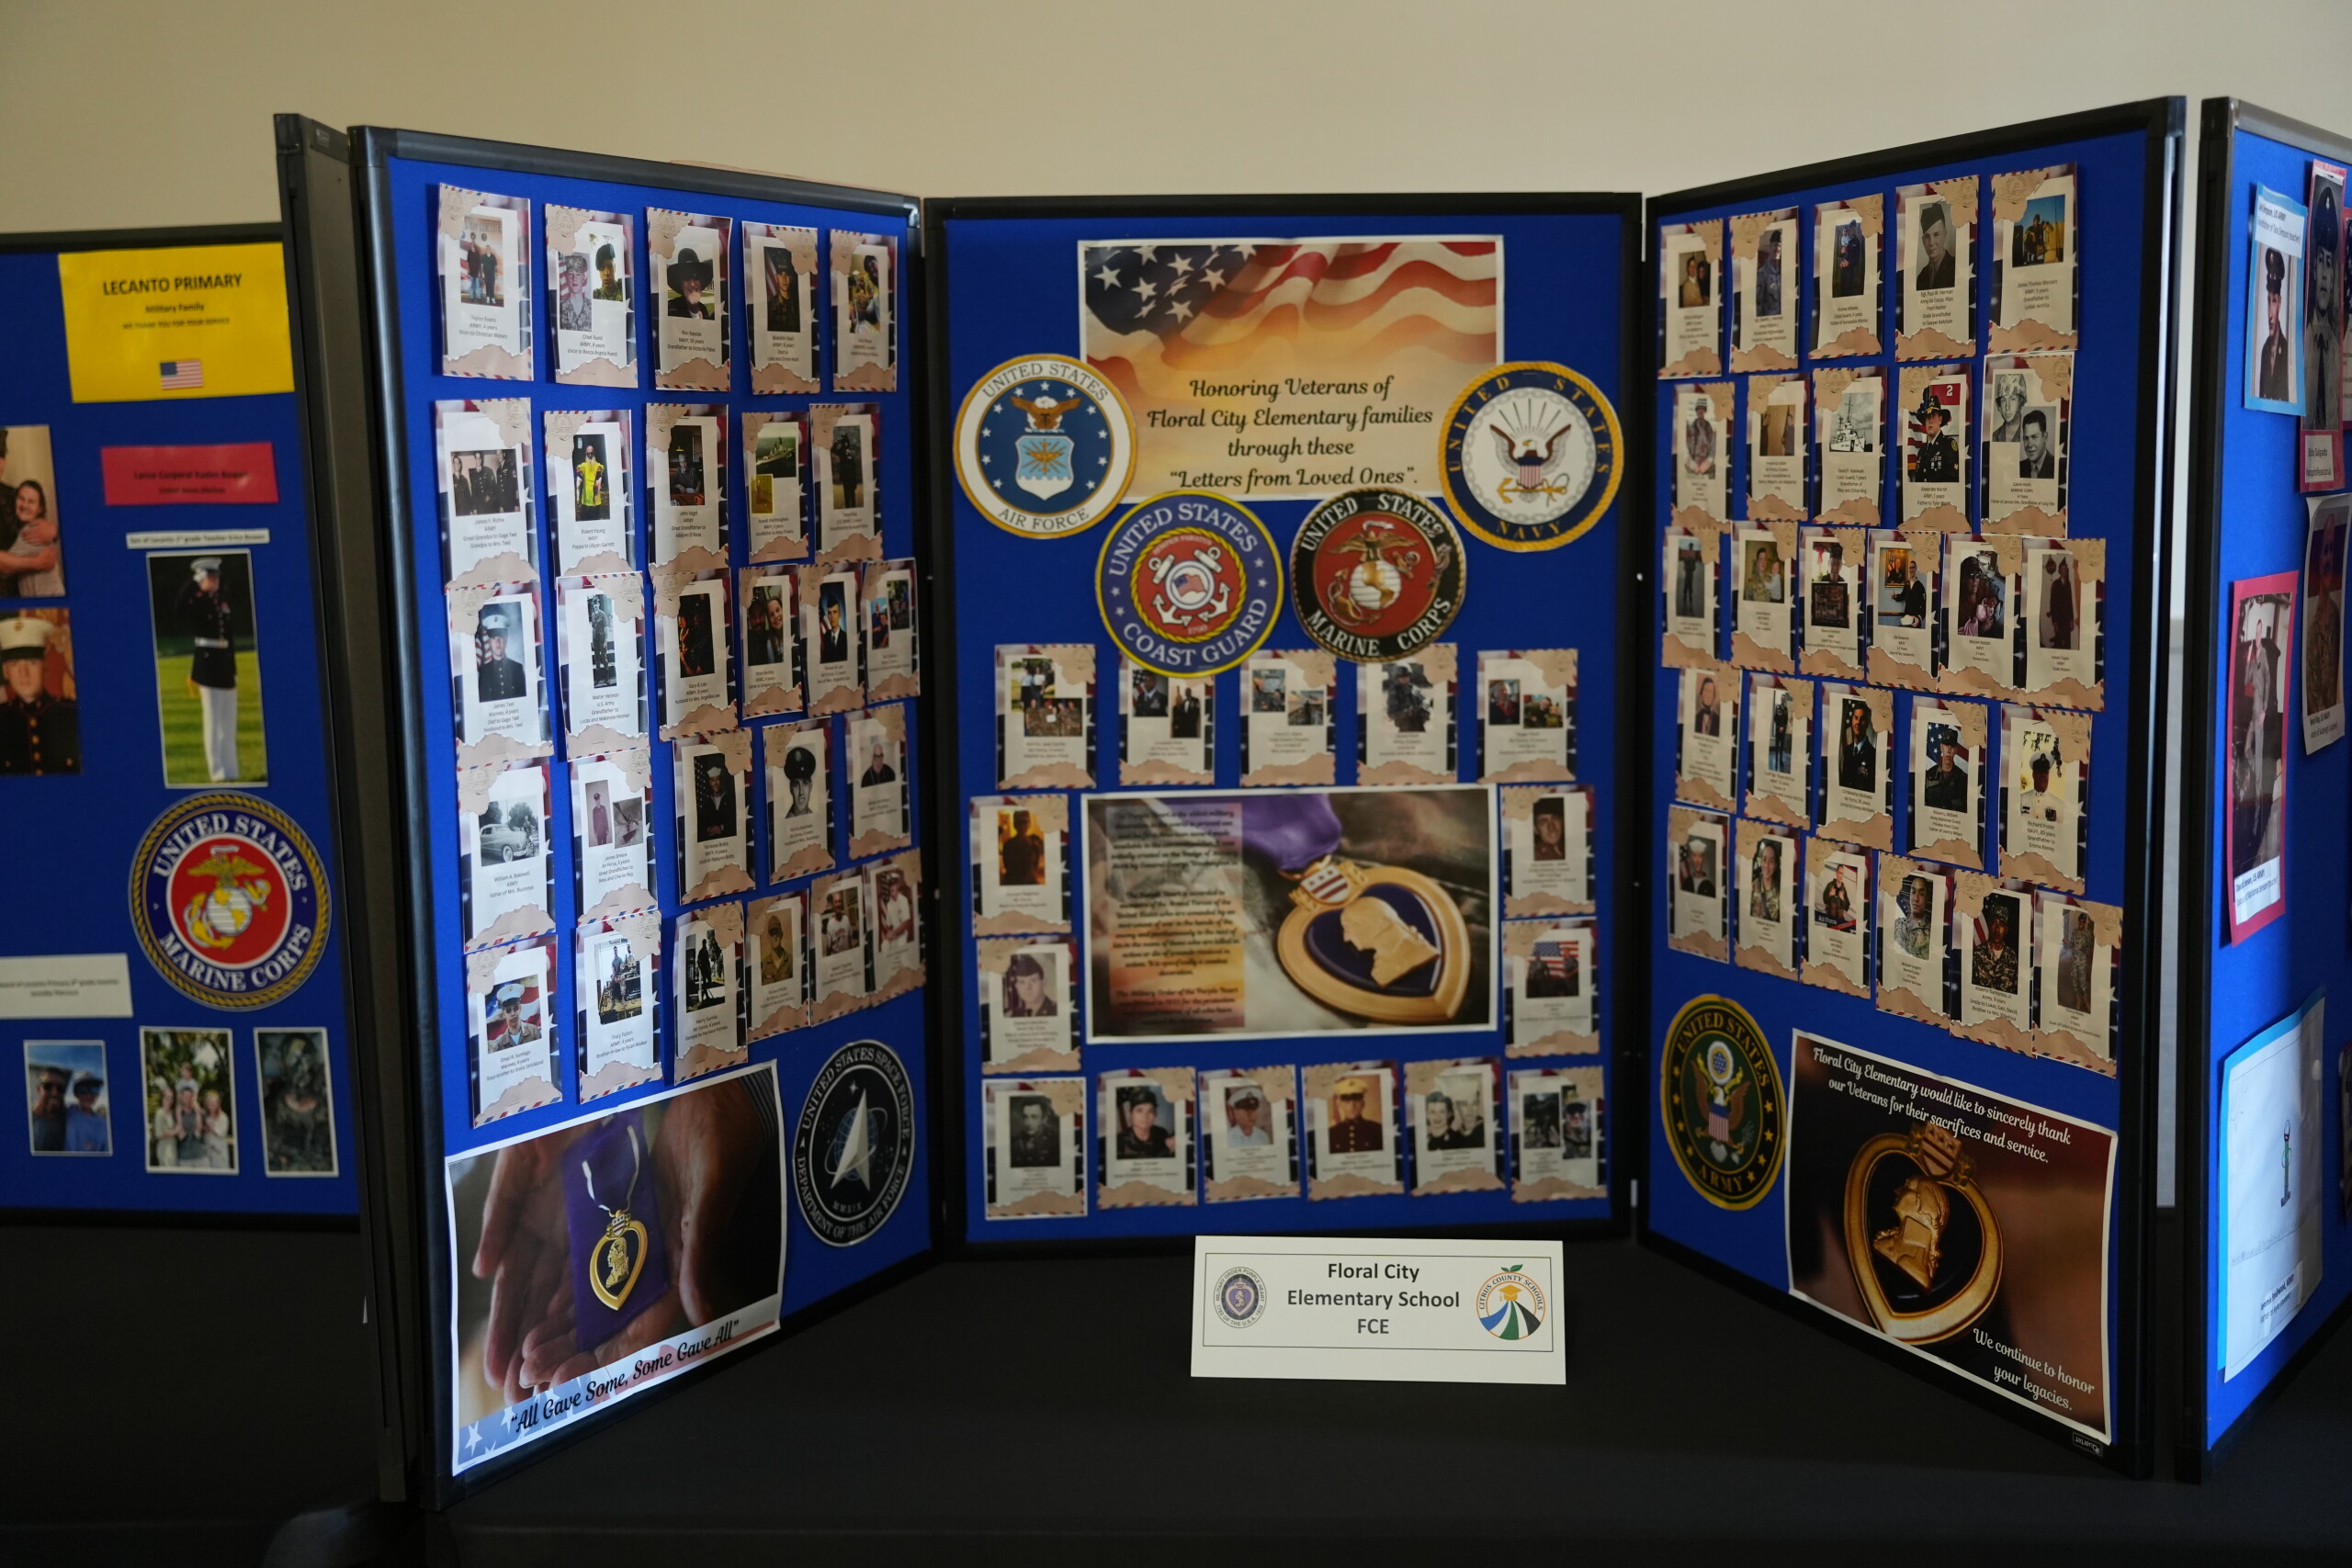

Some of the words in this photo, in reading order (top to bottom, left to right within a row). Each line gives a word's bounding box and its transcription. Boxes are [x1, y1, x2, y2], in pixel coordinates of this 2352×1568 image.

[103, 277, 170, 296] LECANTO
[175, 273, 243, 291] PRIMARY
[145, 304, 176, 314] Military
[178, 302, 204, 313] Family
[982, 363, 1043, 399] UNITED
[1049, 363, 1109, 401] STATES
[1190, 379, 1280, 403] Honoring
[1284, 378, 1368, 396] Veterans
[1374, 375, 1395, 401] of
[1147, 409, 1205, 428] Floral
[1211, 409, 1248, 434] City
[1253, 409, 1359, 433] Elementary
[1359, 405, 1434, 433] families
[1448, 376, 1510, 472] UNITED
[1554, 378, 1611, 474] STATES
[1227, 438, 1303, 463] through
[1306, 436, 1355, 456] these
[1244, 468, 1292, 494] from
[1295, 467, 1353, 486] Loved
[998, 508, 1026, 528] AIR
[1032, 507, 1090, 531] FORCE
[1108, 507, 1173, 577] UNITED
[1178, 502, 1258, 553] STATES
[1300, 497, 1359, 552] UNITED
[1377, 492, 1444, 539] STATES
[1496, 520, 1561, 540] NAVY
[1123, 622, 1198, 667] COAST
[1202, 597, 1268, 663] GUARD
[1306, 608, 1381, 657] MARINE
[1396, 597, 1452, 650] CORPS
[153, 813, 230, 877] UNITED
[233, 814, 308, 891] STATES
[158, 931, 247, 991] MARINE
[250, 923, 312, 988] CORPS
[1677, 1012, 1724, 1055] UNITED
[1726, 1017, 1770, 1088] STATES
[801, 1067, 835, 1130] UNITED
[834, 1046, 875, 1073] STATES
[874, 1050, 902, 1086] SPACE
[895, 1083, 910, 1140] FORCE
[1813, 1047, 1843, 1069] Floral
[1843, 1055, 1862, 1080] City
[1864, 1064, 1919, 1100] Elementary
[1919, 1084, 1953, 1106] would
[1953, 1093, 1973, 1112] like
[1973, 1101, 1985, 1116] to
[1986, 1106, 2036, 1138] sincerely
[2037, 1118, 2072, 1145] thank
[1827, 1078, 1846, 1092] our
[1847, 1079, 1889, 1108] Veterans
[1888, 1096, 1905, 1115] for
[1905, 1100, 1929, 1122] their
[1929, 1111, 1982, 1139] sacrifices
[1983, 1131, 2006, 1148] and
[2007, 1138, 2048, 1164] service.
[797, 1156, 833, 1235] DEPARTMENT
[832, 1224, 846, 1239] OF
[846, 1221, 866, 1237] THE
[867, 1208, 885, 1229] AIR
[883, 1165, 906, 1211] FORCE
[1699, 1164, 1744, 1193] ARMY
[1216, 1279, 1226, 1302] MILITARY
[1224, 1268, 1242, 1280] ORDER
[1242, 1269, 1261, 1284] PURPLE
[1328, 1262, 1378, 1279] Floral
[1384, 1263, 1420, 1283] City
[1478, 1283, 1492, 1310] CITRUS
[1492, 1274, 1523, 1285] COUNTY
[1523, 1279, 1544, 1311] SCHOOLS
[1287, 1289, 1393, 1311] Elementary
[1397, 1291, 1460, 1307] School
[1357, 1318, 1389, 1335] FCE
[543, 1392, 582, 1420] Gave
[585, 1372, 628, 1402] Some,
[632, 1352, 673, 1381] Some
[676, 1337, 711, 1362] Gave
[1973, 1327, 1994, 1349] We
[1995, 1341, 2042, 1371] continue
[2043, 1361, 2056, 1378] to
[2057, 1364, 2095, 1394] honor
[1994, 1365, 2021, 1386] your
[2023, 1373, 2073, 1411] legacies.
